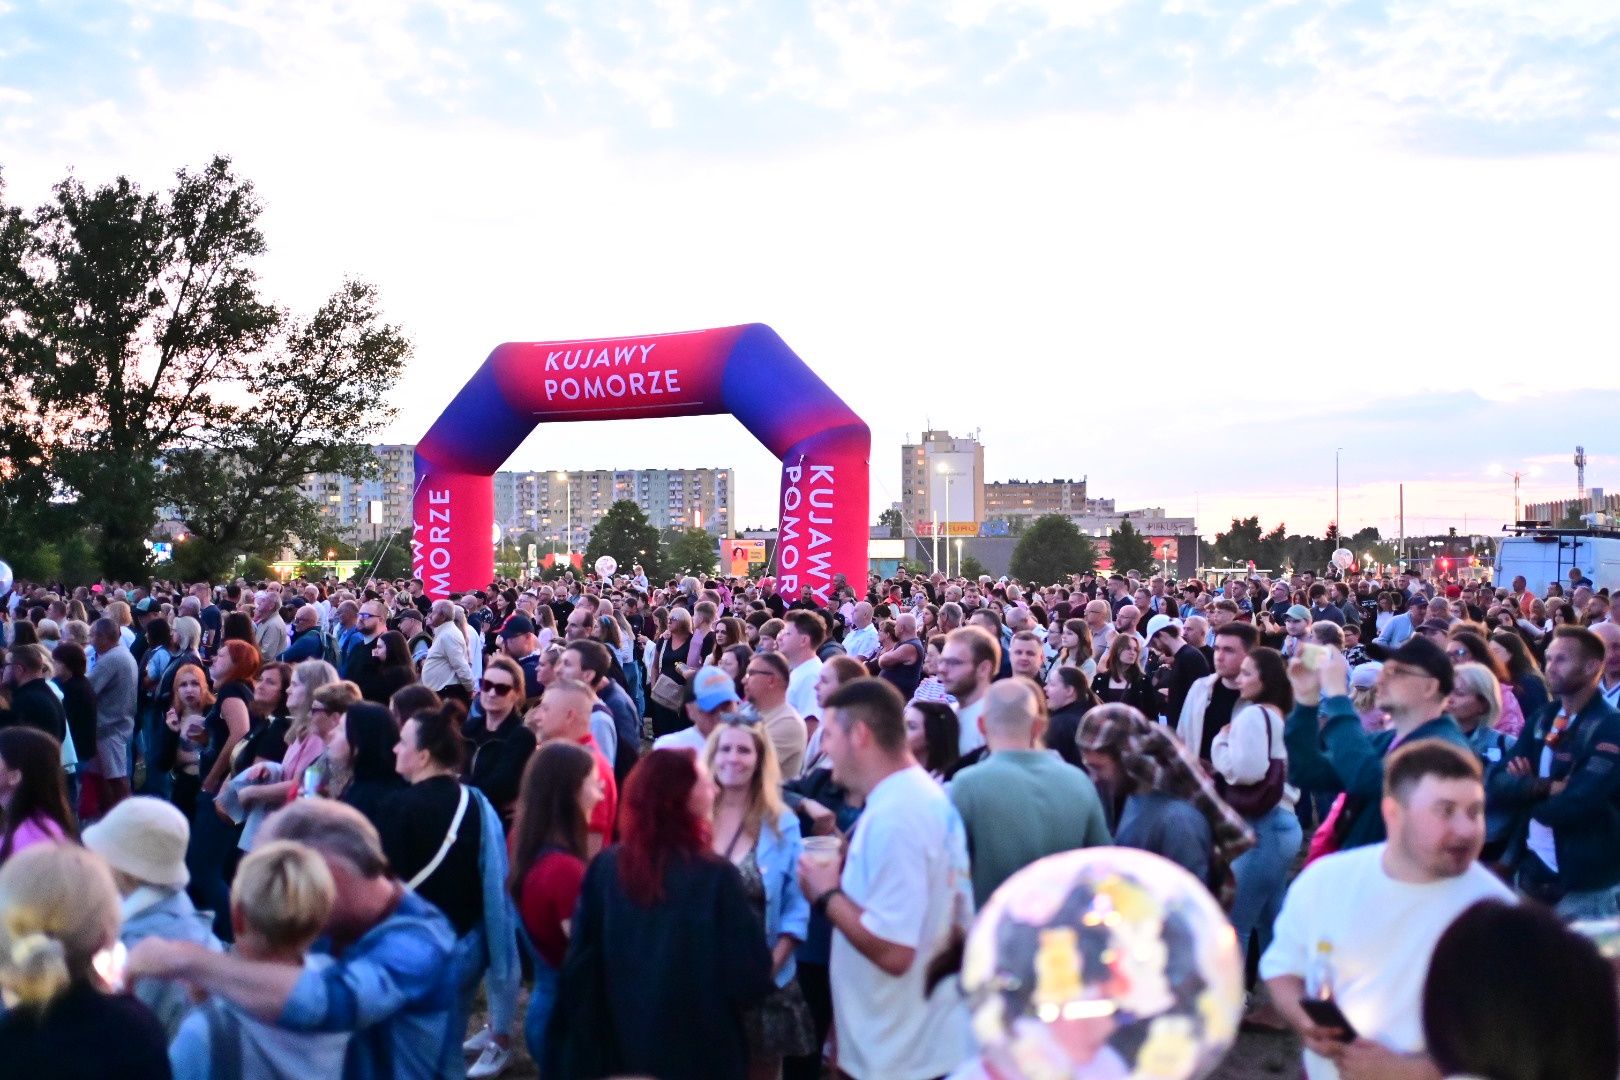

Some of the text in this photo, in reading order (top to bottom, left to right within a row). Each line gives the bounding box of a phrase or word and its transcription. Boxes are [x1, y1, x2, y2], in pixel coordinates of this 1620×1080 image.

[545, 343, 656, 371] KUJAWY
[545, 369, 681, 400] POMORZE
[413, 520, 424, 579] AWY
[429, 489, 451, 595] MORZE
[780, 466, 802, 609] POMOR
[806, 465, 834, 604] KUJAWY
